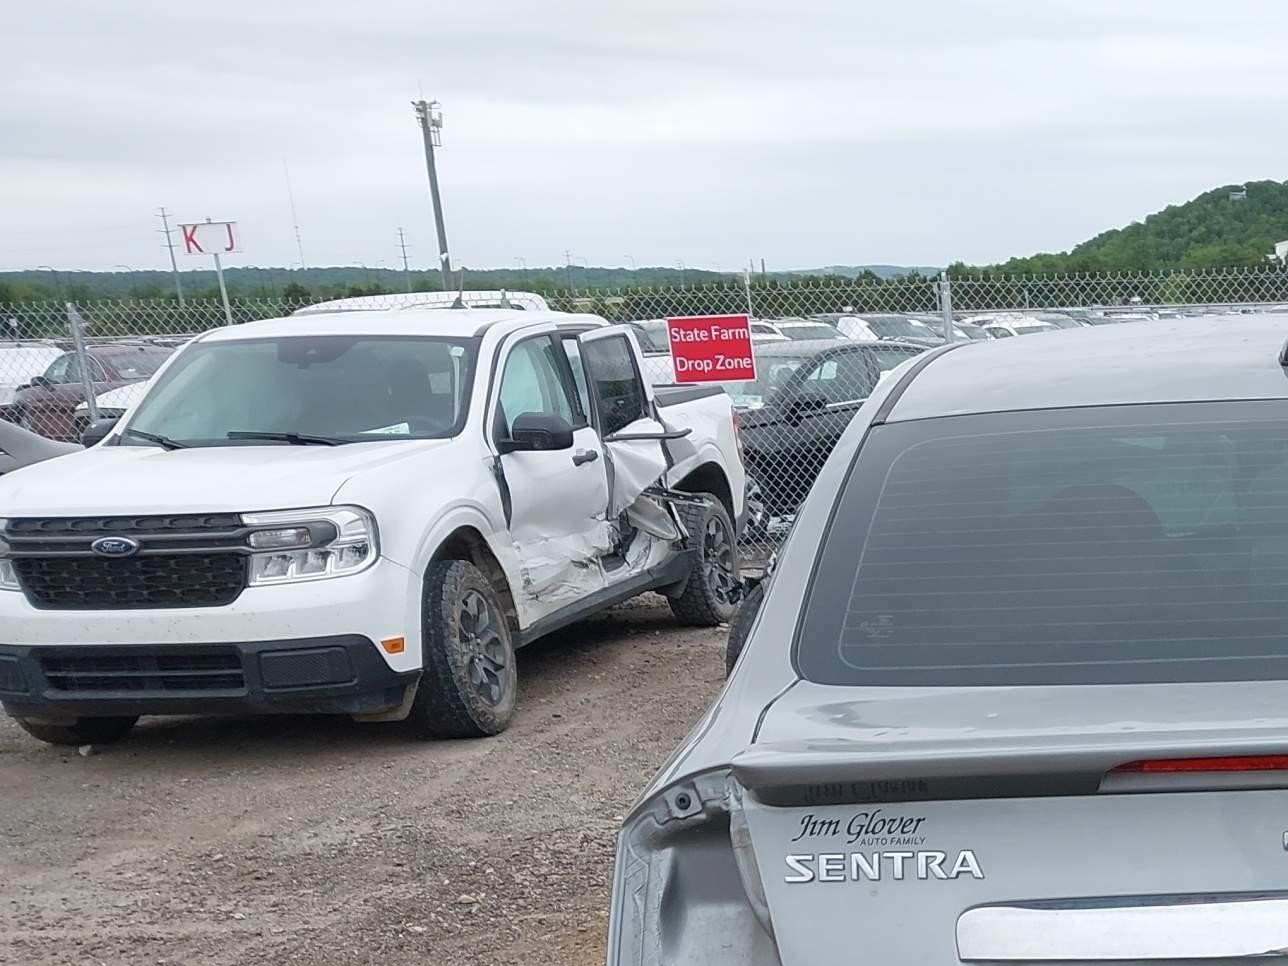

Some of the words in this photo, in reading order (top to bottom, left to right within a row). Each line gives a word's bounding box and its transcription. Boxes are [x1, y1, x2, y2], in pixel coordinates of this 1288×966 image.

[182, 224, 204, 254] K
[223, 223, 234, 252] J
[671, 327, 709, 342] State
[711, 325, 749, 341] Farm
[676, 356, 712, 373] Drop
[714, 354, 752, 370] Zone
[792, 814, 841, 842] Jim
[846, 808, 926, 845] Glover
[859, 836, 888, 846] AUTO
[889, 836, 926, 846] FAMILY
[784, 849, 985, 884] SENTRA
